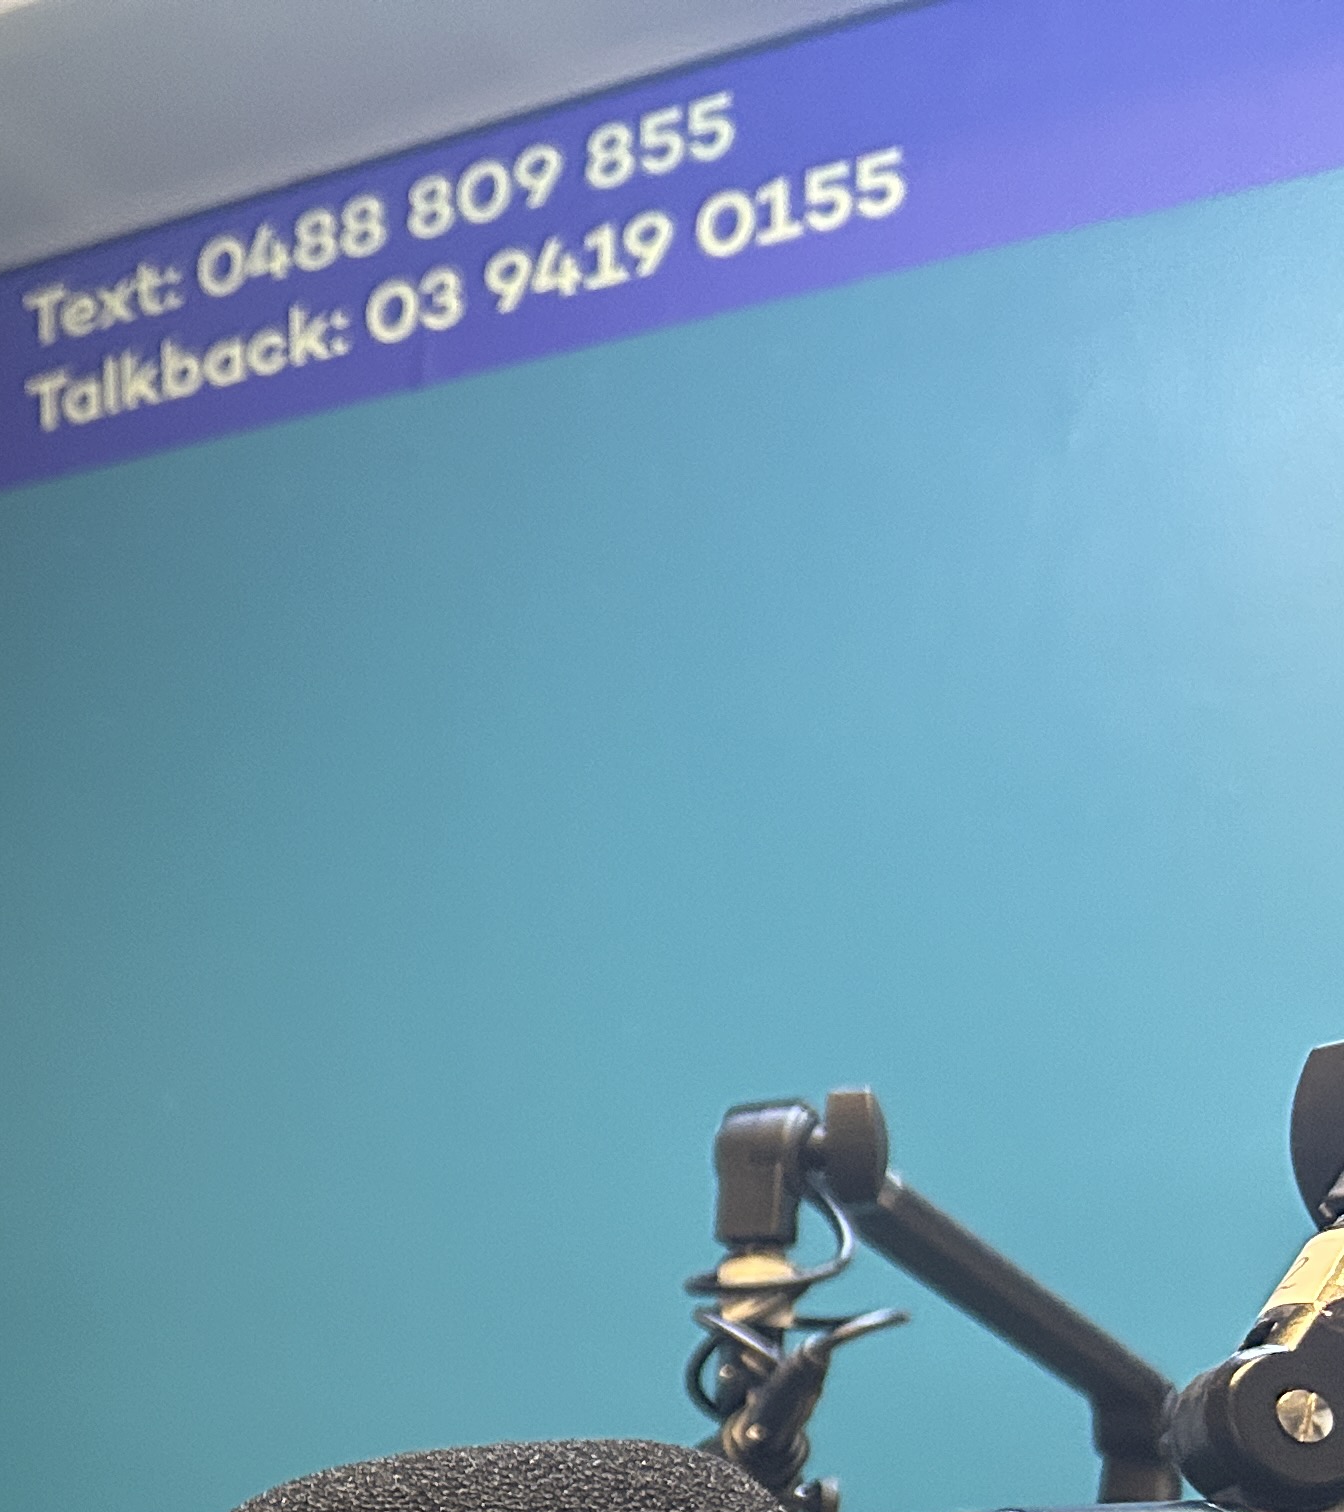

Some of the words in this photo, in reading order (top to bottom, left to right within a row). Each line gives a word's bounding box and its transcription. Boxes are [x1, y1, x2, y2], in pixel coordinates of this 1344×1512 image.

[22, 260, 184, 346] Text:
[196, 193, 388, 298] 0488
[405, 143, 564, 240] 809
[584, 90, 736, 190] 855
[24, 303, 351, 432] Talkback:
[365, 264, 466, 345] 03
[483, 210, 675, 315] 9419
[695, 146, 908, 258] 0155
